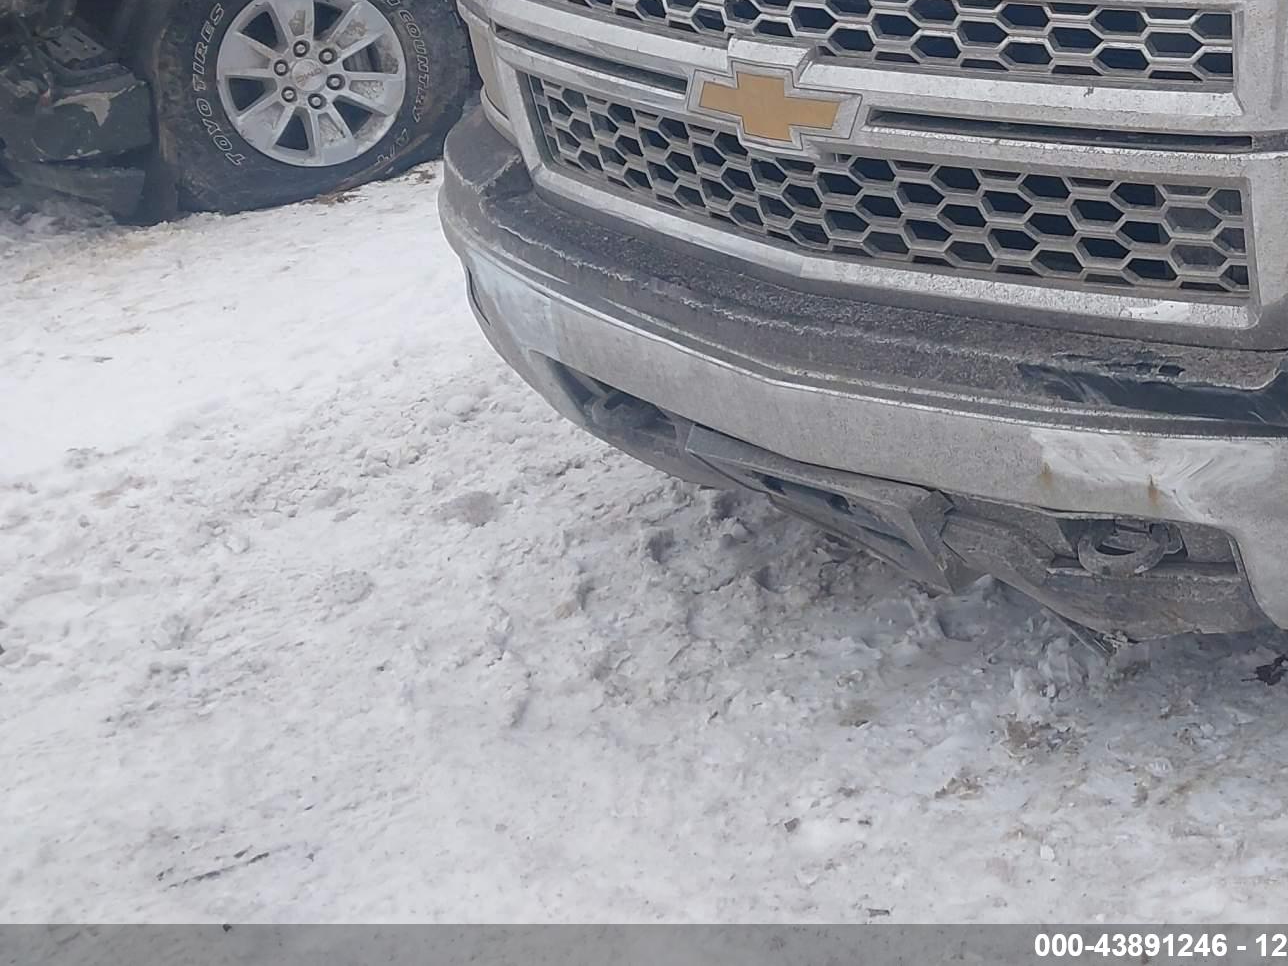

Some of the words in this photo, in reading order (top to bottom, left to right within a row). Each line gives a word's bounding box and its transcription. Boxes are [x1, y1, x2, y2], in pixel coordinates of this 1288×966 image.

[192, 2, 225, 92] TIRES
[399, 9, 430, 123] COUNTRY
[195, 97, 246, 167] TOYO
